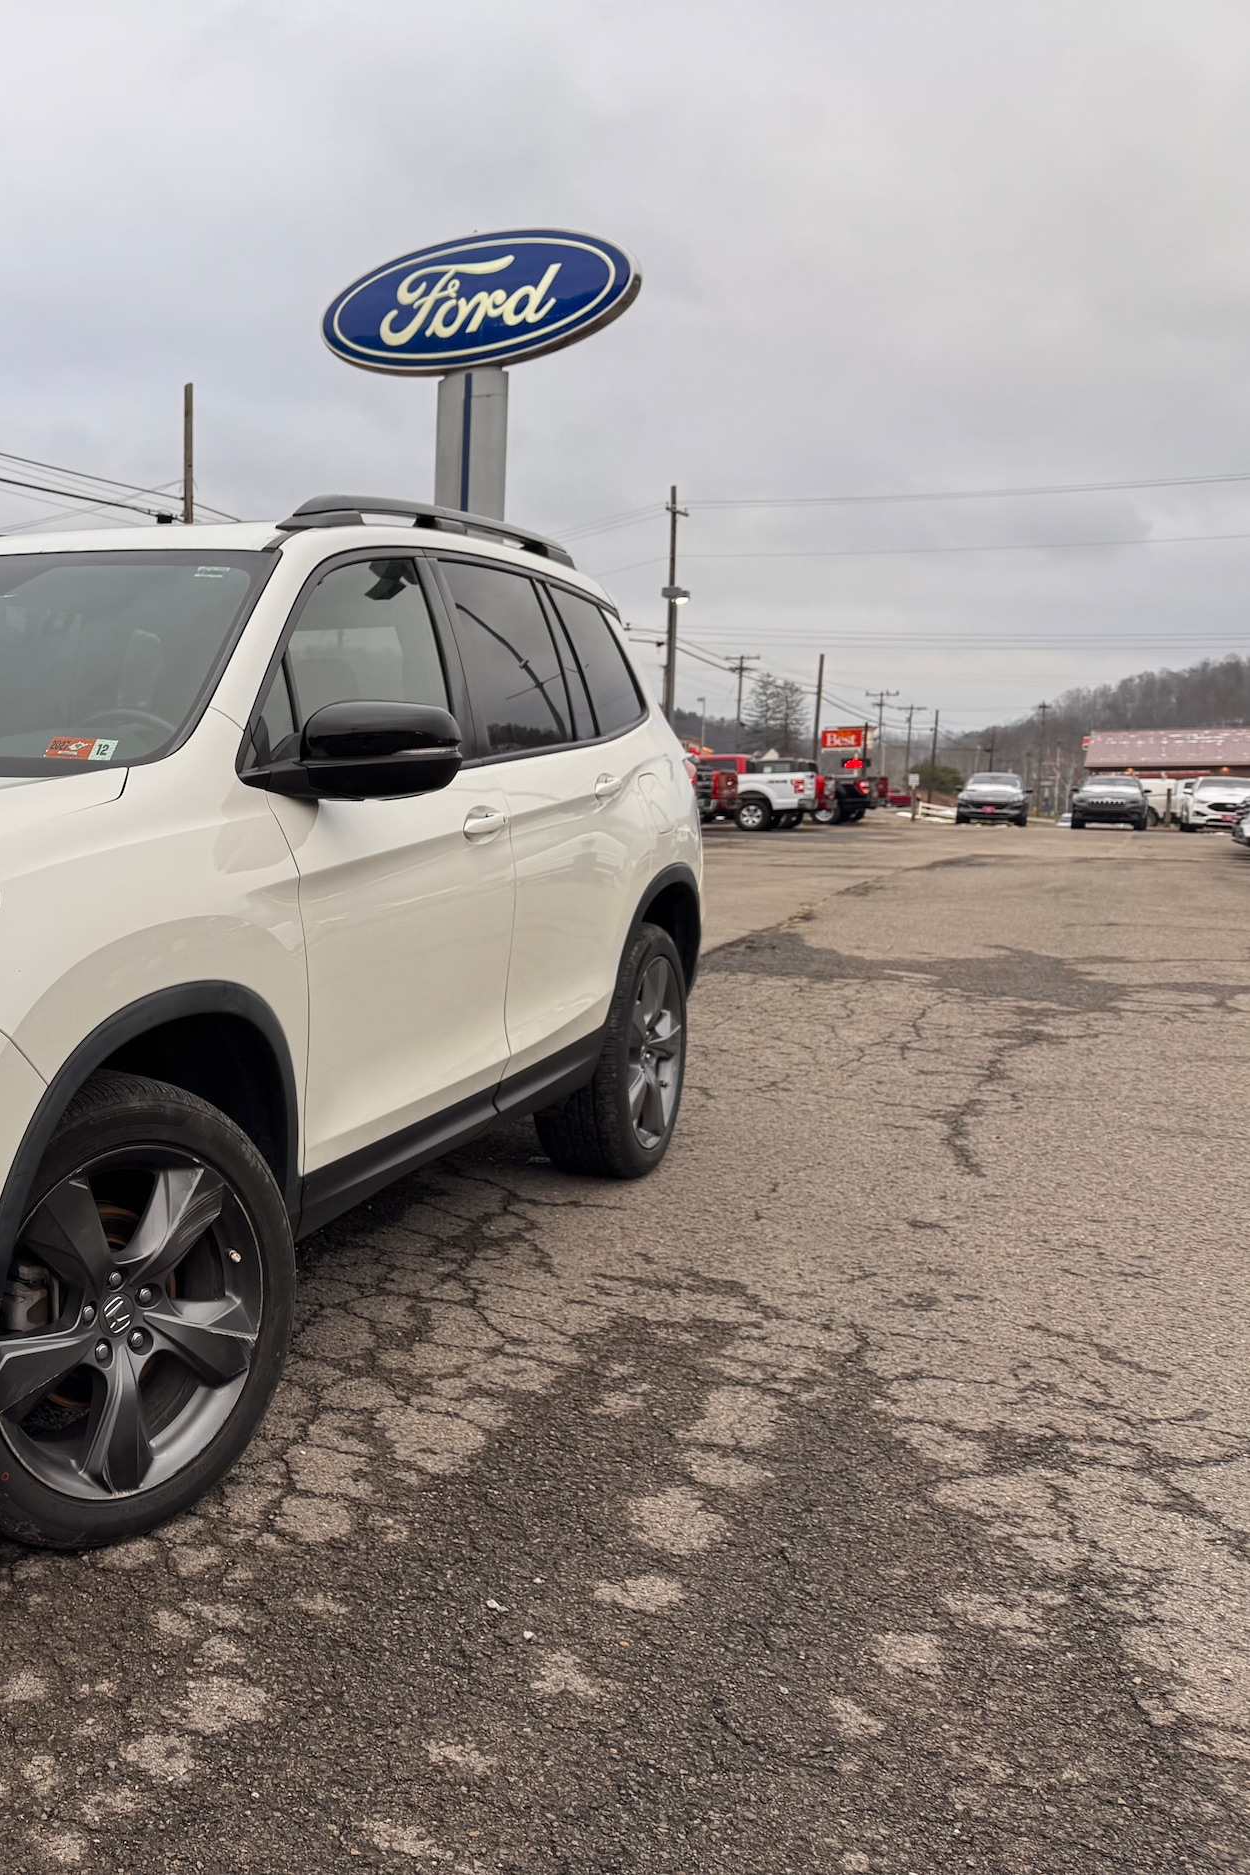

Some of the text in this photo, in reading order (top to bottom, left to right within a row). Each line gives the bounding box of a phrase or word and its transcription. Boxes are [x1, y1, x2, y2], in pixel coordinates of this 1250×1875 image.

[379, 254, 562, 346] Ford
[50, 740, 71, 751] 2027
[826, 733, 857, 747] Best
[96, 744, 109, 756] 12
